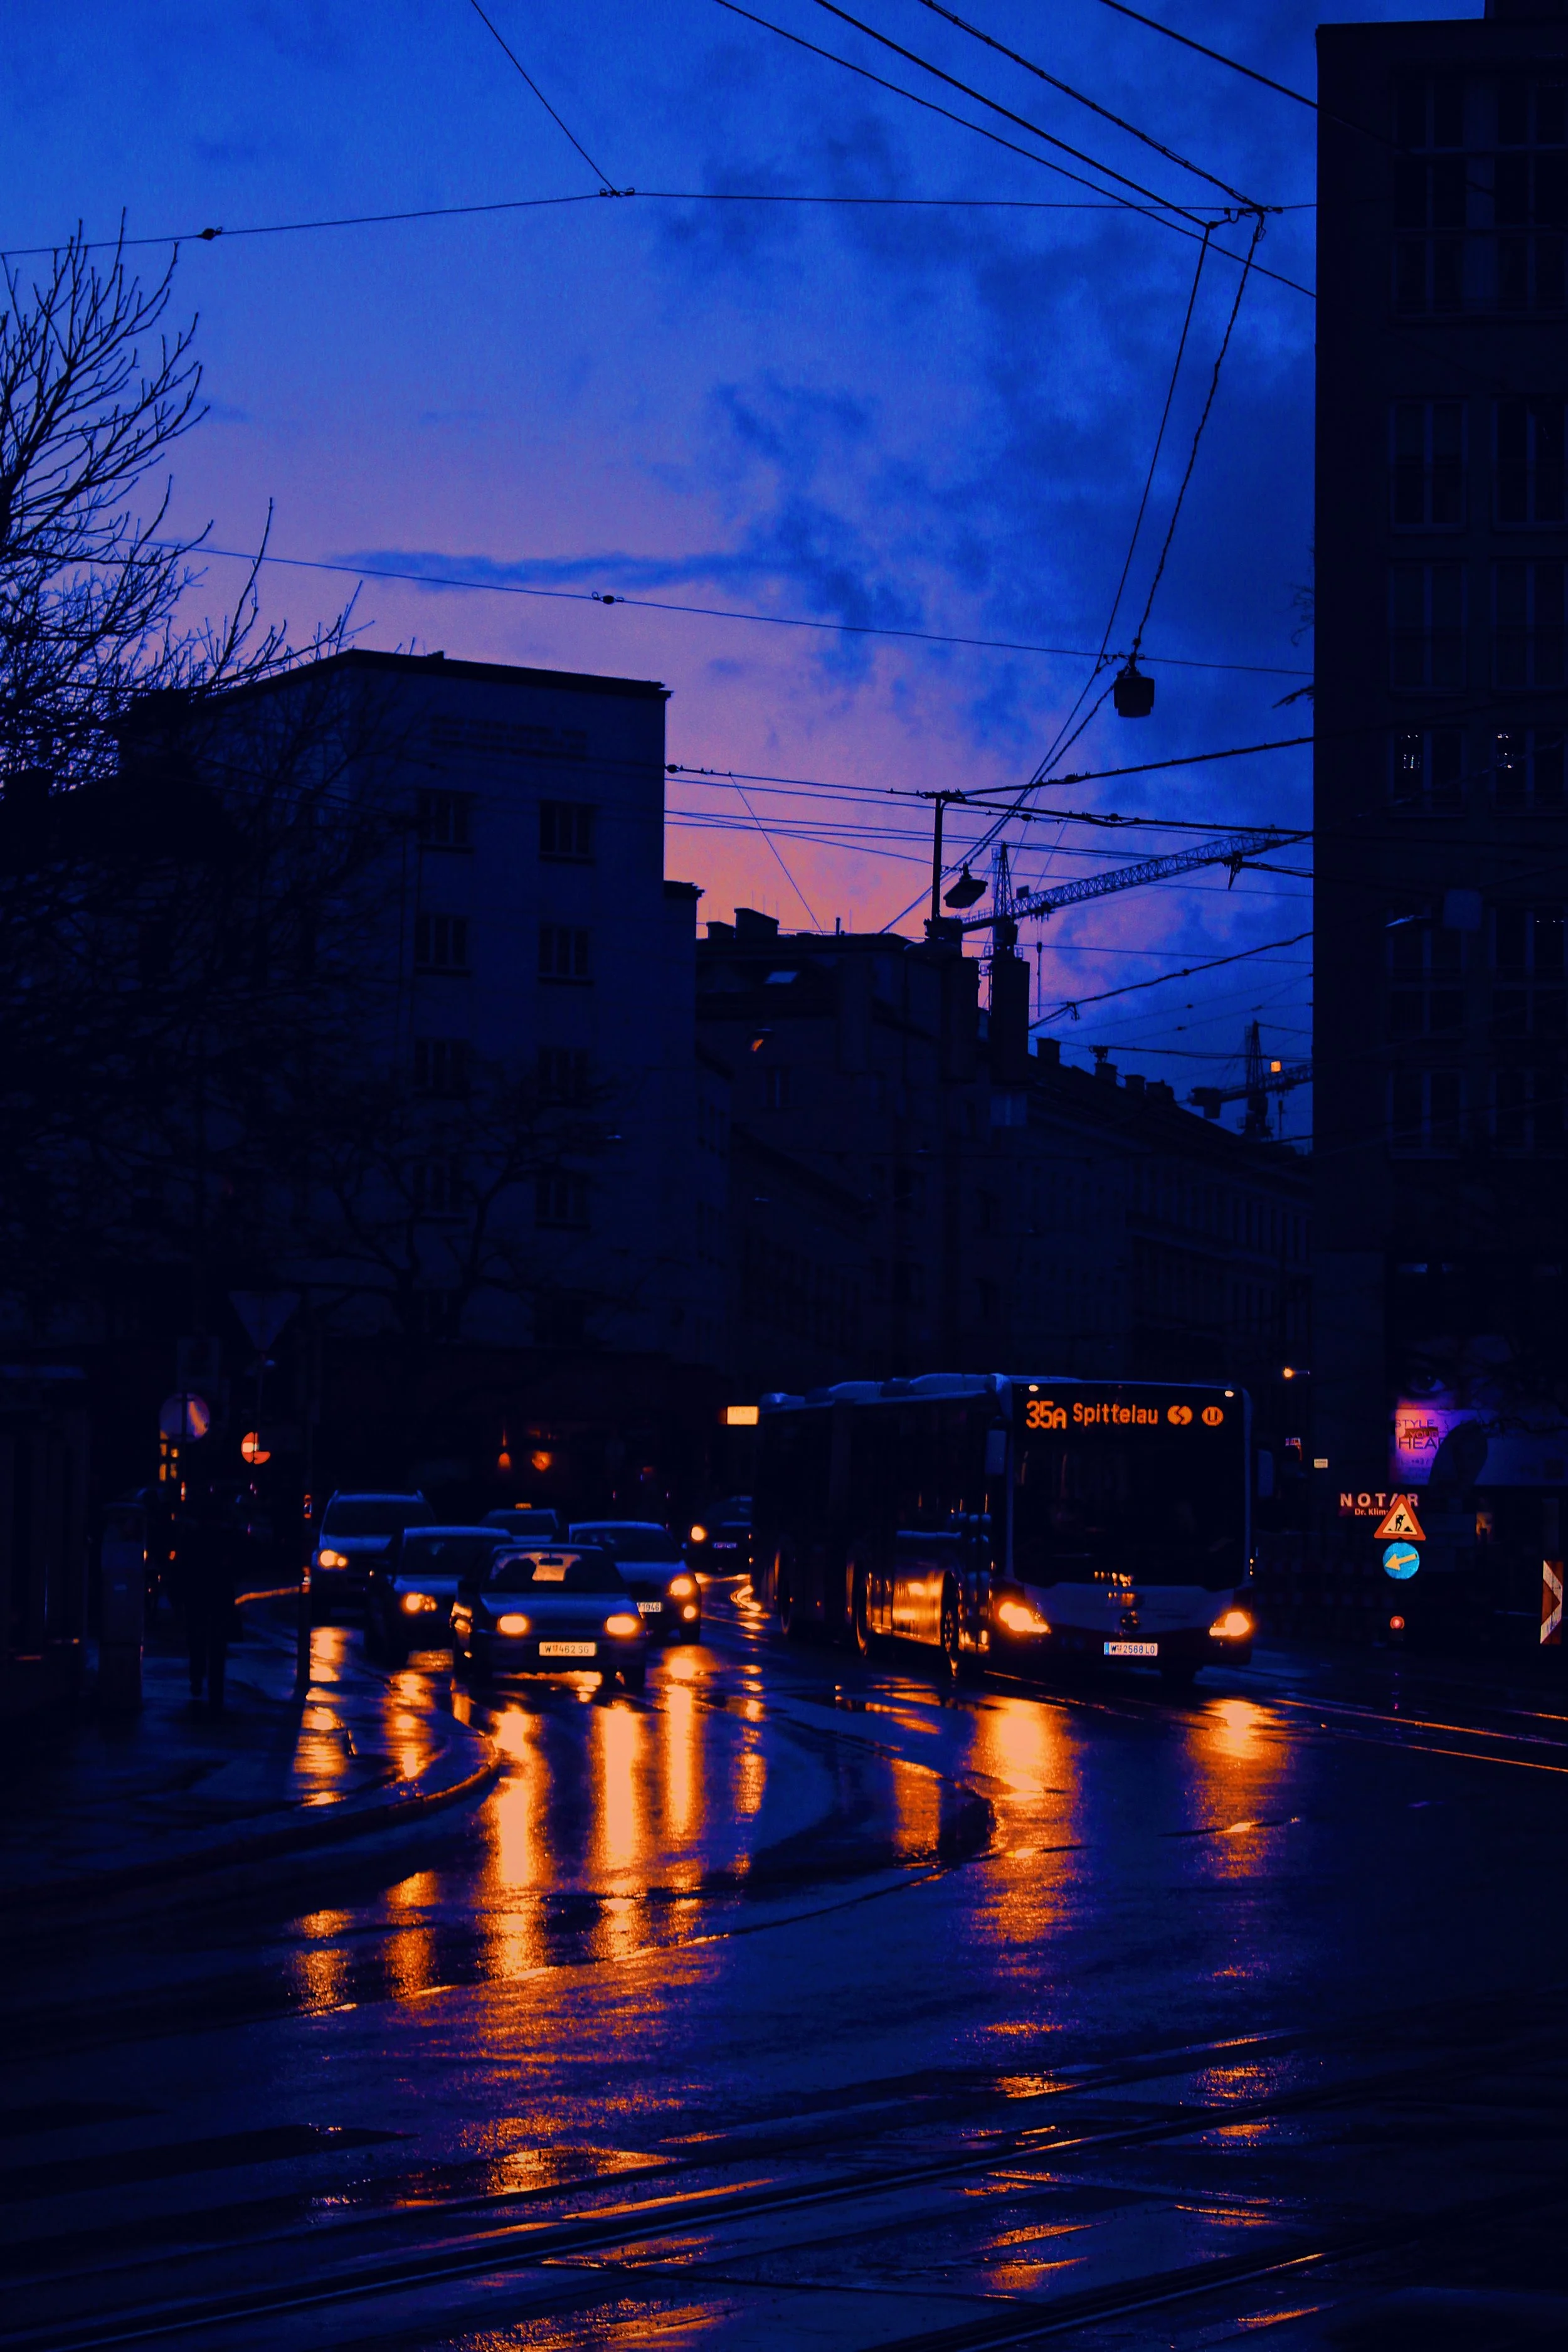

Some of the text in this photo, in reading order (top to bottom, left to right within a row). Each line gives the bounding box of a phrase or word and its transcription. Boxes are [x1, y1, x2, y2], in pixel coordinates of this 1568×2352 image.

[1026, 1400, 1066, 1429] 35A
[1073, 1402, 1158, 1427] Spittelau
[1396, 1419, 1435, 1428] STYLE
[1409, 1430, 1438, 1438] YOUR
[559, 1645, 576, 1654] 462
